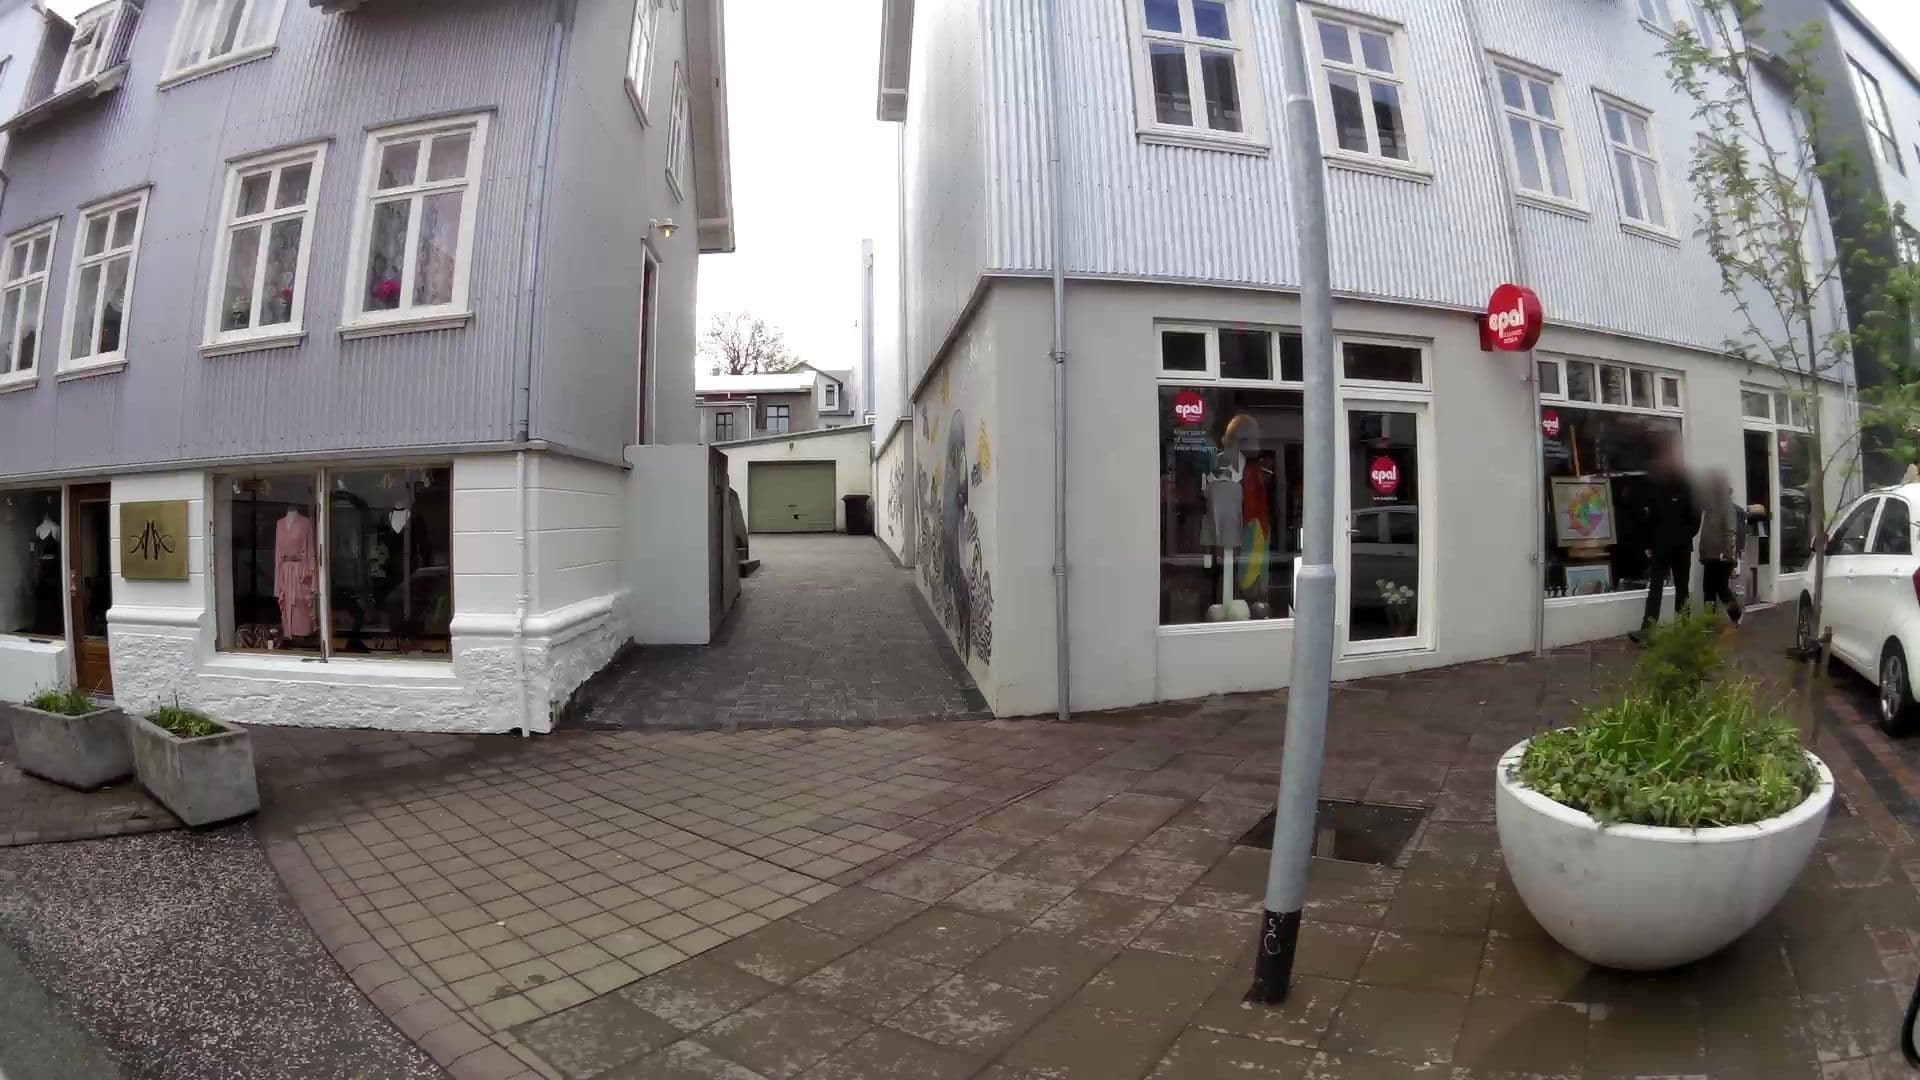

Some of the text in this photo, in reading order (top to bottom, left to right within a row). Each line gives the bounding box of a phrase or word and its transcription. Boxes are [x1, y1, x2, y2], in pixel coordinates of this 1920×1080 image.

[1489, 297, 1524, 338] epal
[1175, 399, 1202, 418] epal
[1542, 416, 1559, 431] epal
[1372, 465, 1396, 484] epal
